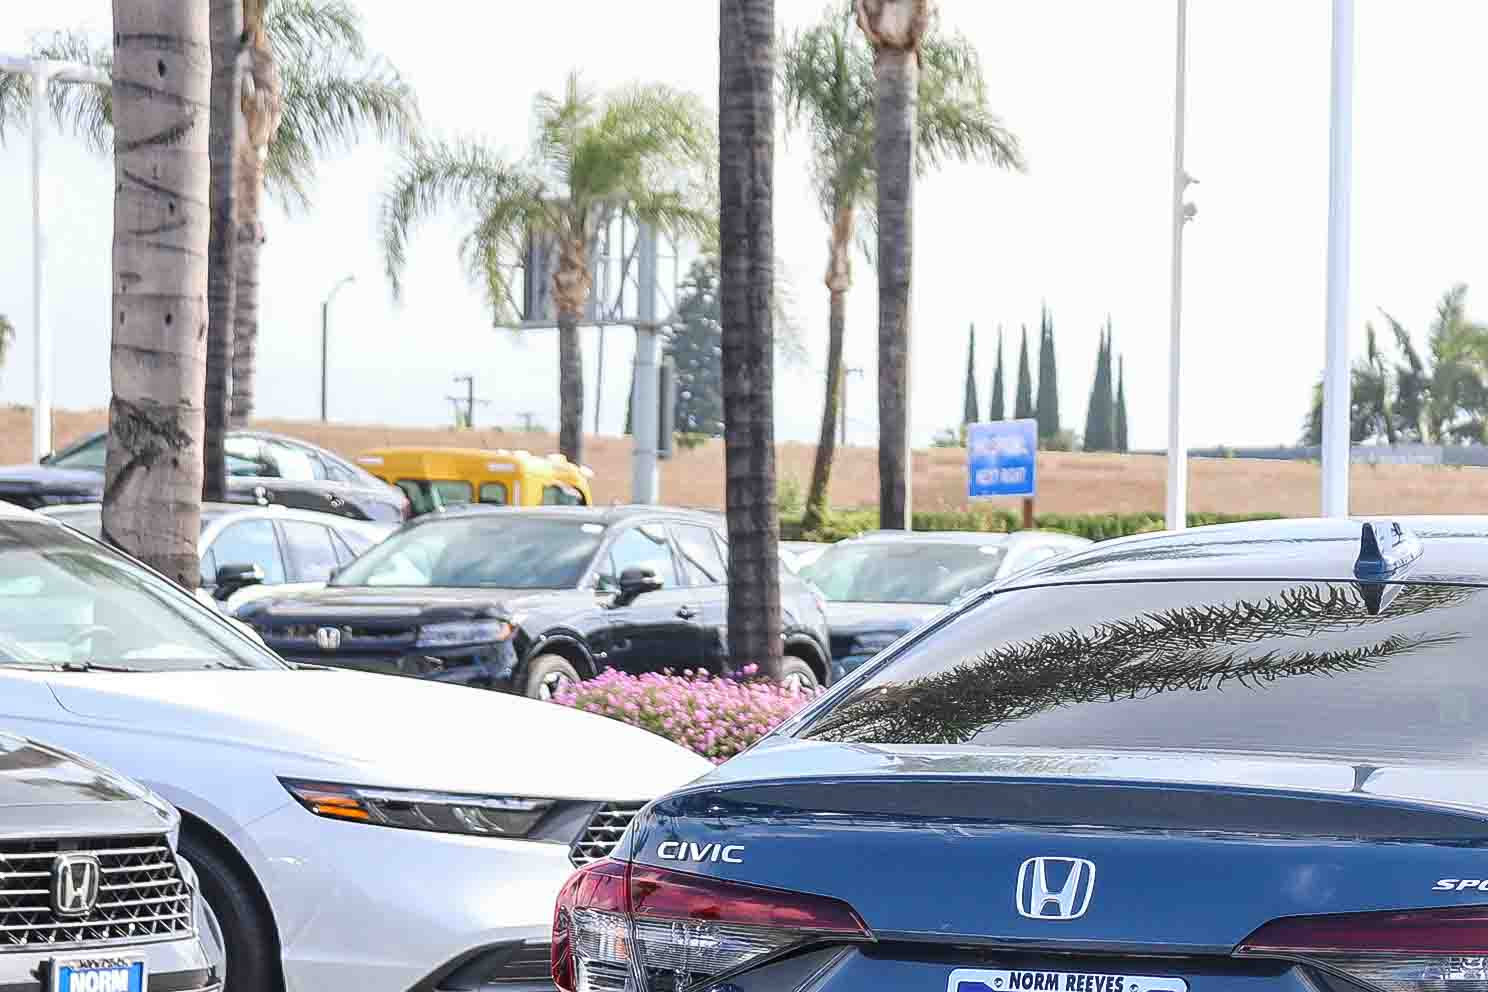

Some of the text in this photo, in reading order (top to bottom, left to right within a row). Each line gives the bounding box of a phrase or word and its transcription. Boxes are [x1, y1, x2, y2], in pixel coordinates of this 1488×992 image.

[657, 841, 745, 863] CIVIC
[1009, 972, 1124, 992] NORM REEVES
